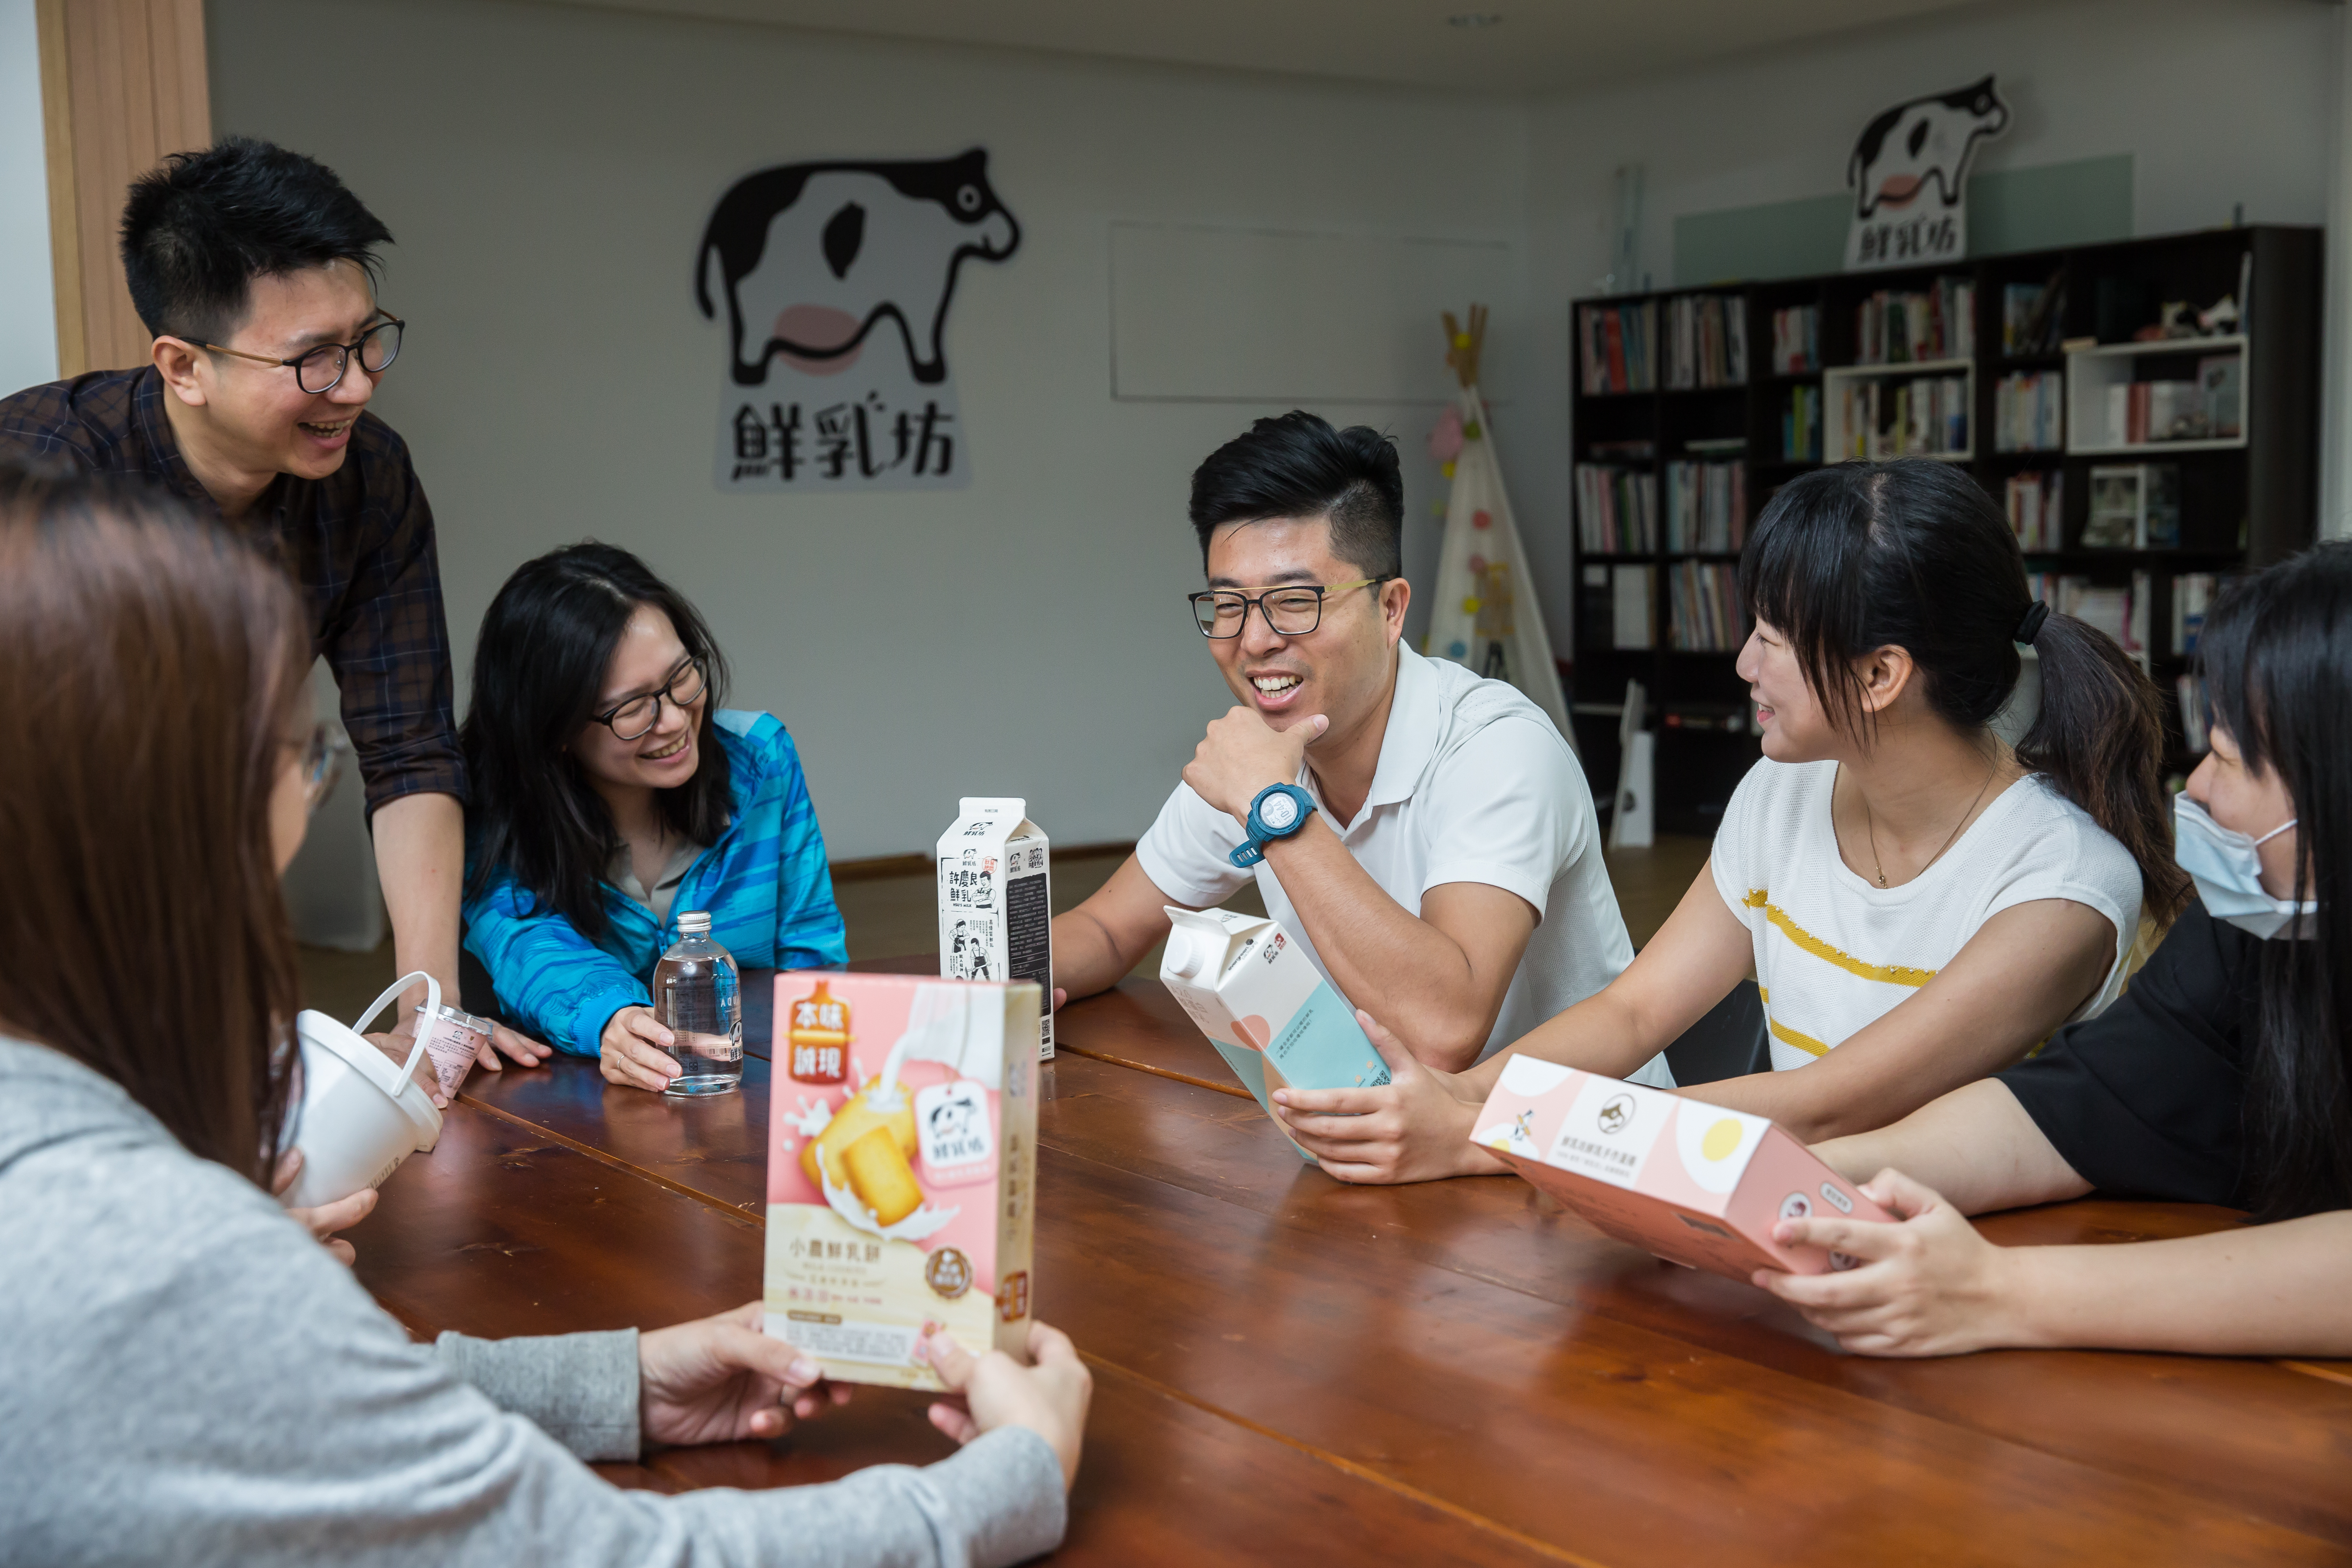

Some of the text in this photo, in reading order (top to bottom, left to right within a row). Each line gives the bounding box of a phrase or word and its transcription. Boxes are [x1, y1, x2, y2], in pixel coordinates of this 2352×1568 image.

[731, 392, 954, 479] 鮮乳坊
[1273, 800, 1292, 821] 10:44
[949, 870, 978, 887] 許慶良
[950, 887, 972, 902] 鮮乳
[1227, 946, 1249, 971] evergreen
[795, 1002, 844, 1029] 本味
[933, 1135, 984, 1159] 鮮乳坊
